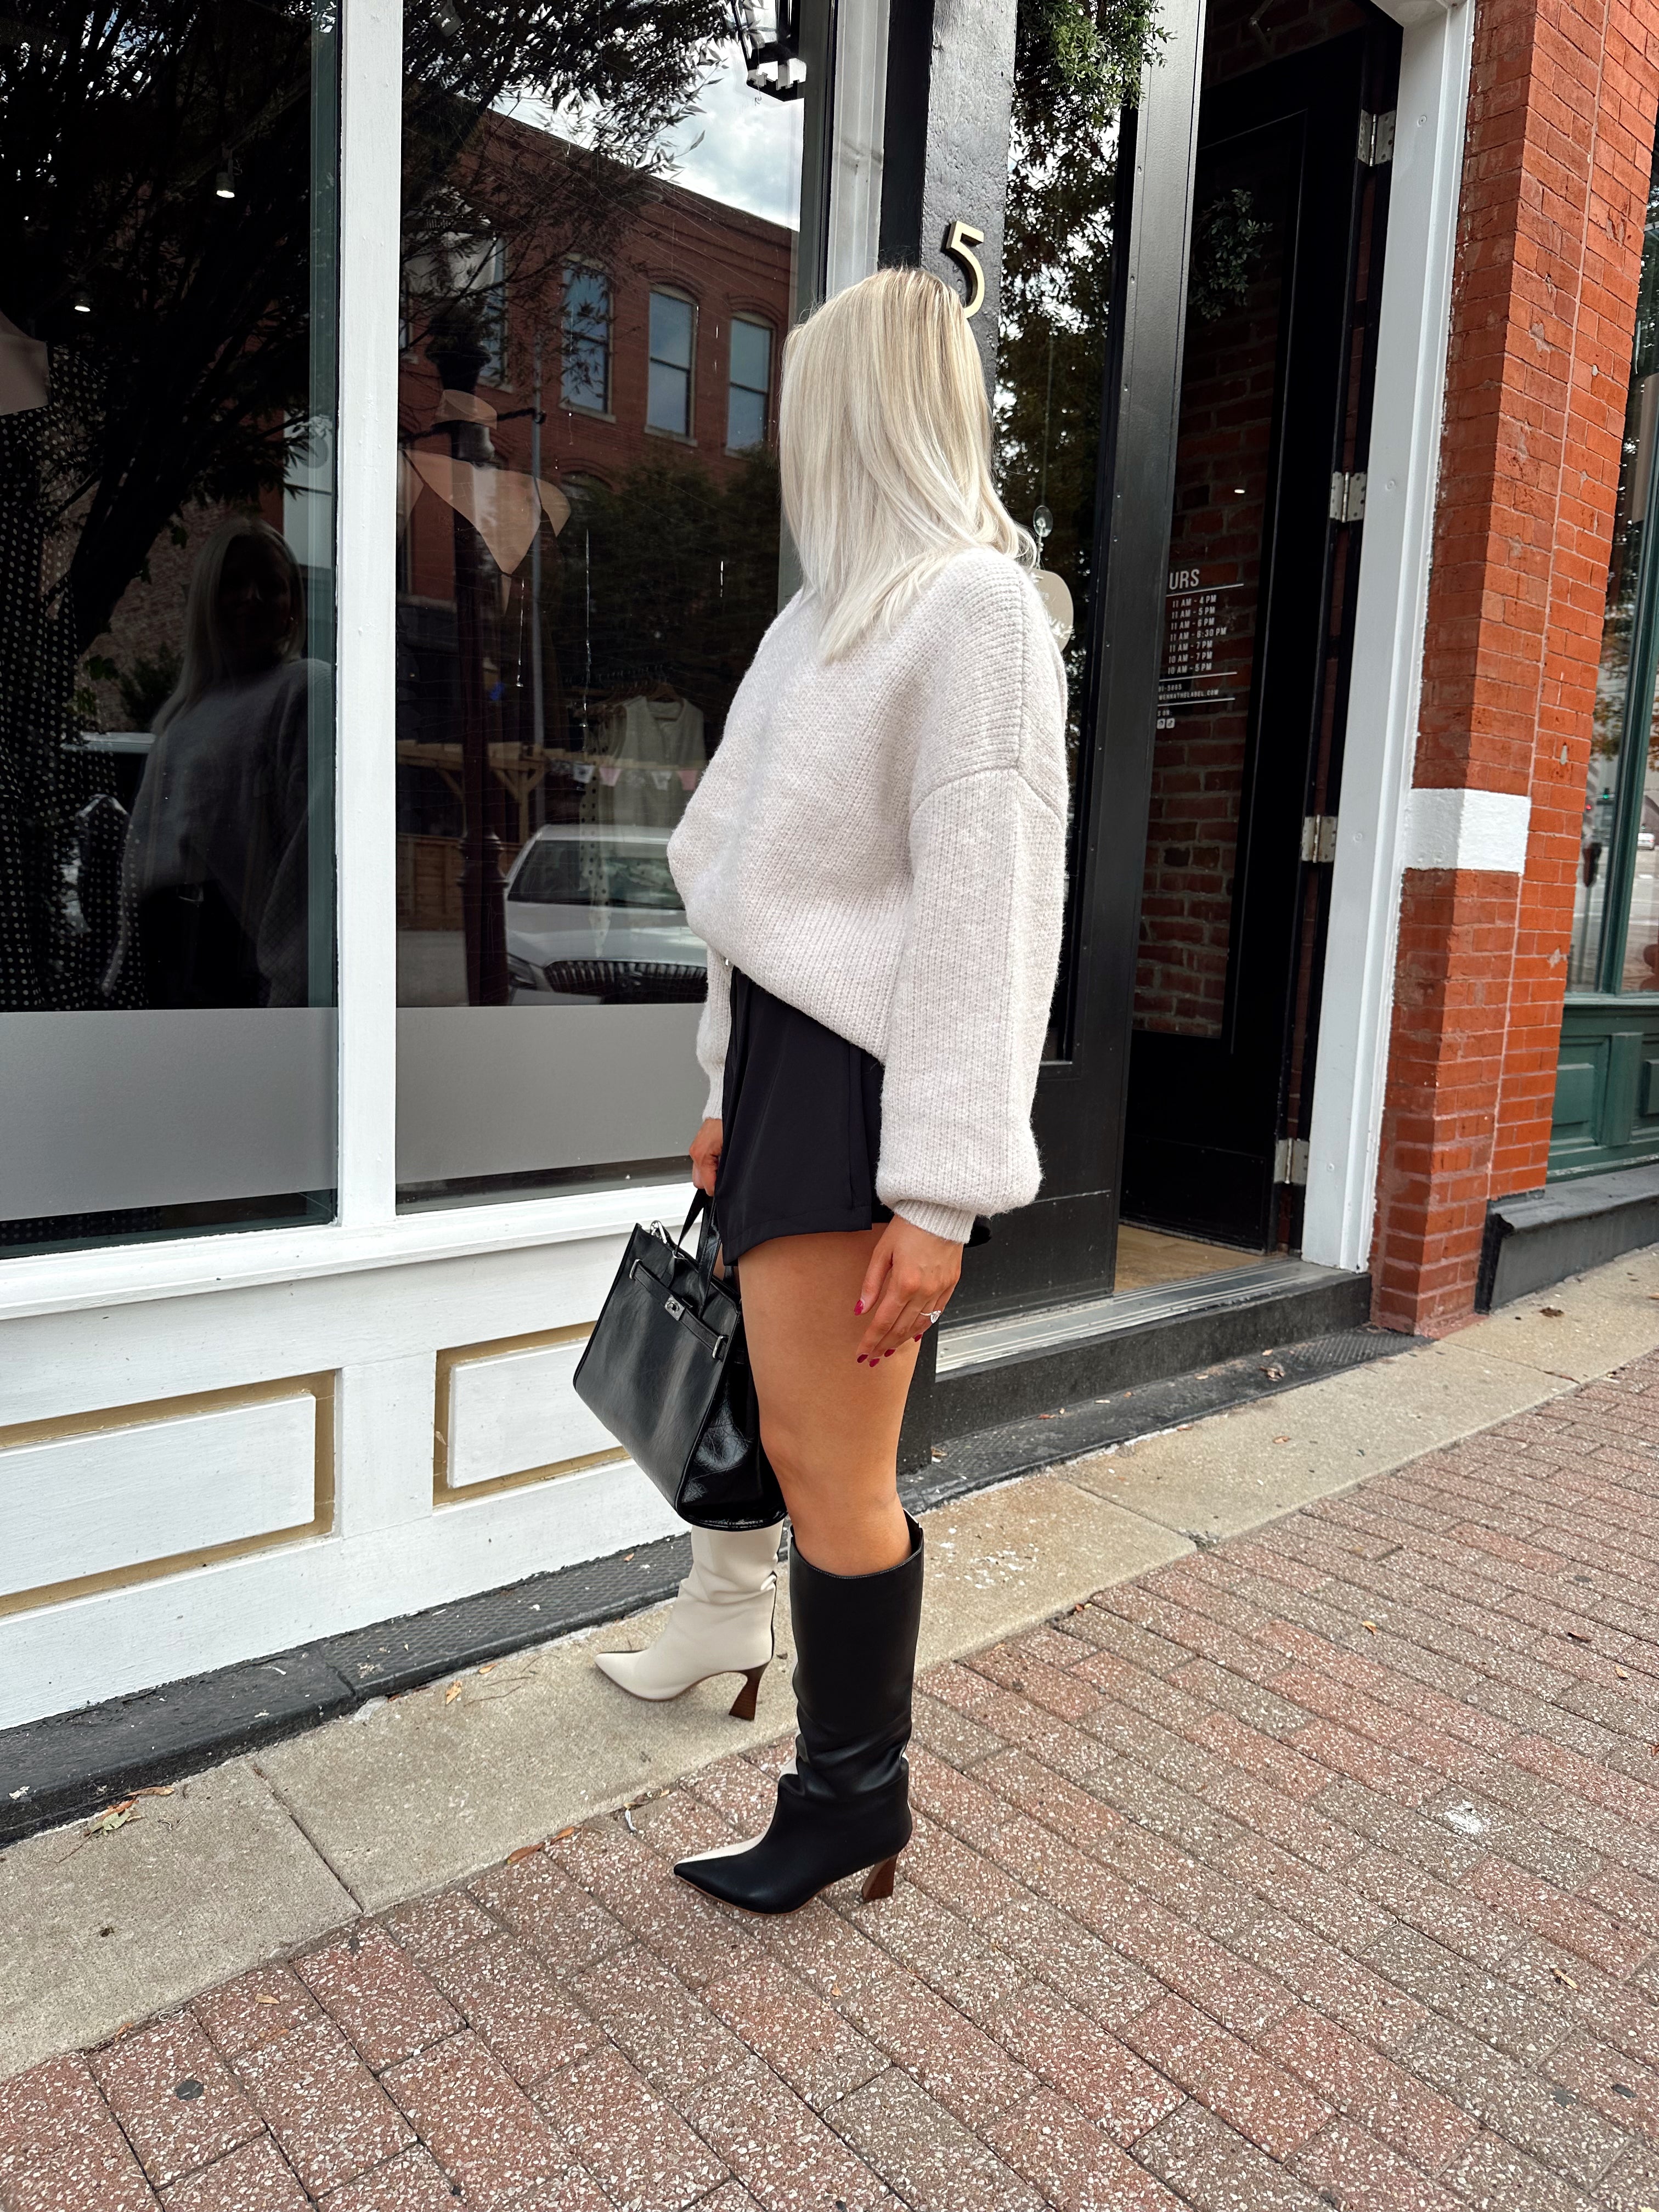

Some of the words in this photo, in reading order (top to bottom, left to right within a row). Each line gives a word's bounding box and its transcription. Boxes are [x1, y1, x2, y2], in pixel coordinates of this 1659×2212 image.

[945, 221, 985, 319] 5
[1169, 569, 1200, 590] URS
[1181, 599, 1192, 607] AM
[1206, 595, 1216, 603] PM
[1180, 610, 1190, 618] AM
[1205, 606, 1215, 614] PM
[1180, 620, 1190, 629] AM
[1204, 618, 1215, 626] PM
[1178, 632, 1189, 640] AM
[1216, 627, 1227, 636] PM
[1178, 643, 1188, 652] AM
[1202, 640, 1212, 648] PM
[1177, 654, 1188, 662] AM
[1201, 652, 1212, 660] PM
[1168, 666, 1175, 674] 10
[1177, 665, 1187, 673] AM
[1201, 663, 1212, 671] PM
